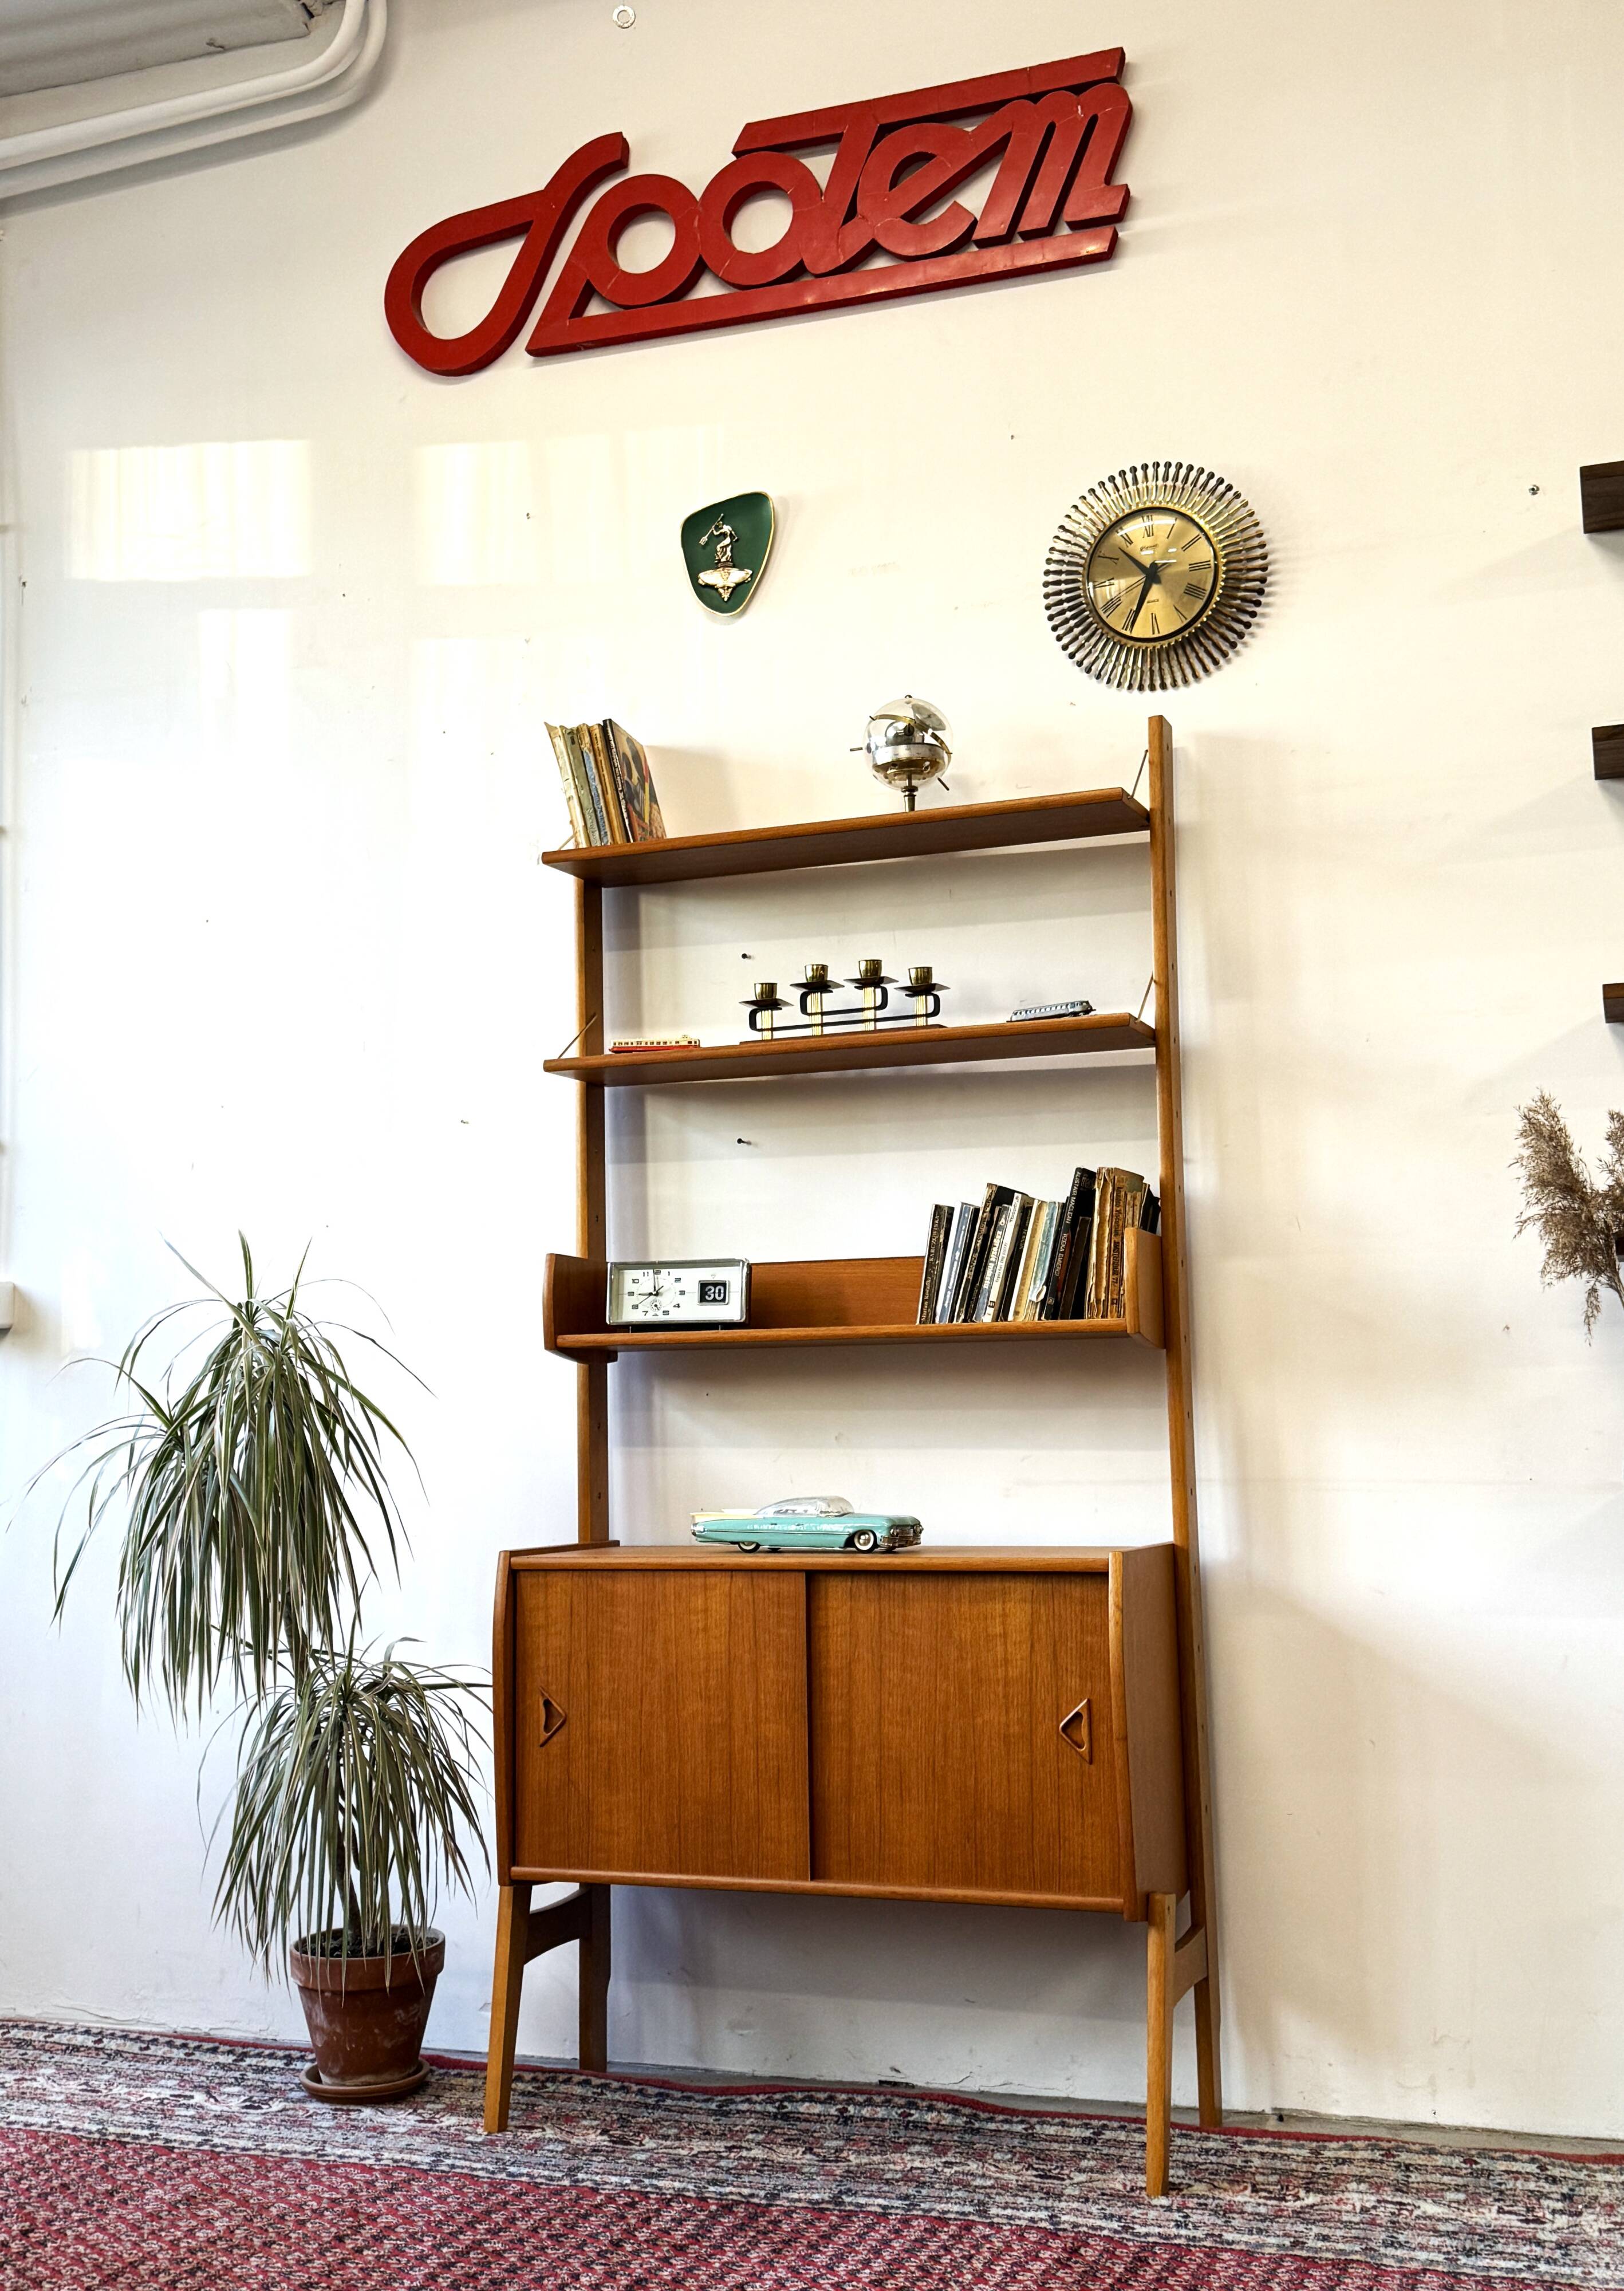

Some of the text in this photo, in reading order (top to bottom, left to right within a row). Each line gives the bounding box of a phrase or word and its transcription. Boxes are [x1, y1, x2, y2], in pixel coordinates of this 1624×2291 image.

[1181, 534, 1201, 552] II
[1189, 560, 1211, 572] III
[705, 1285, 724, 1301] 30
